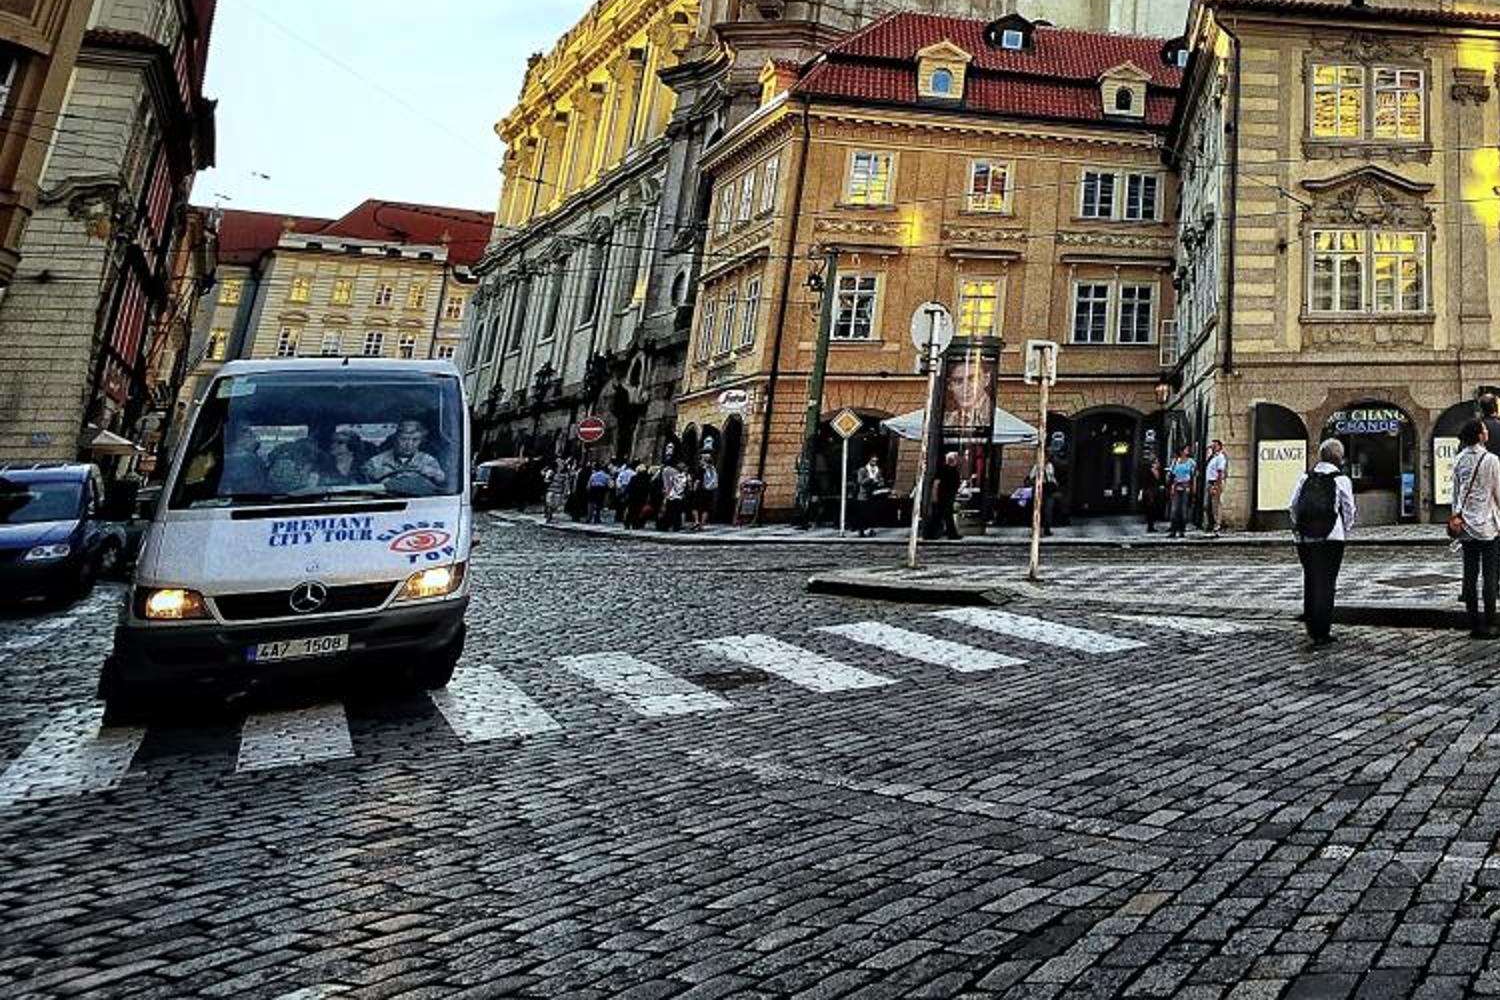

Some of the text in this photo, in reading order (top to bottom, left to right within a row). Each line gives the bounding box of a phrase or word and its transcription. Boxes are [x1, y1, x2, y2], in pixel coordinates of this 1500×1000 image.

[1260, 448, 1305, 461] CHANGE
[271, 515, 375, 535] PREMIANT
[268, 528, 374, 548] CITY TOUR
